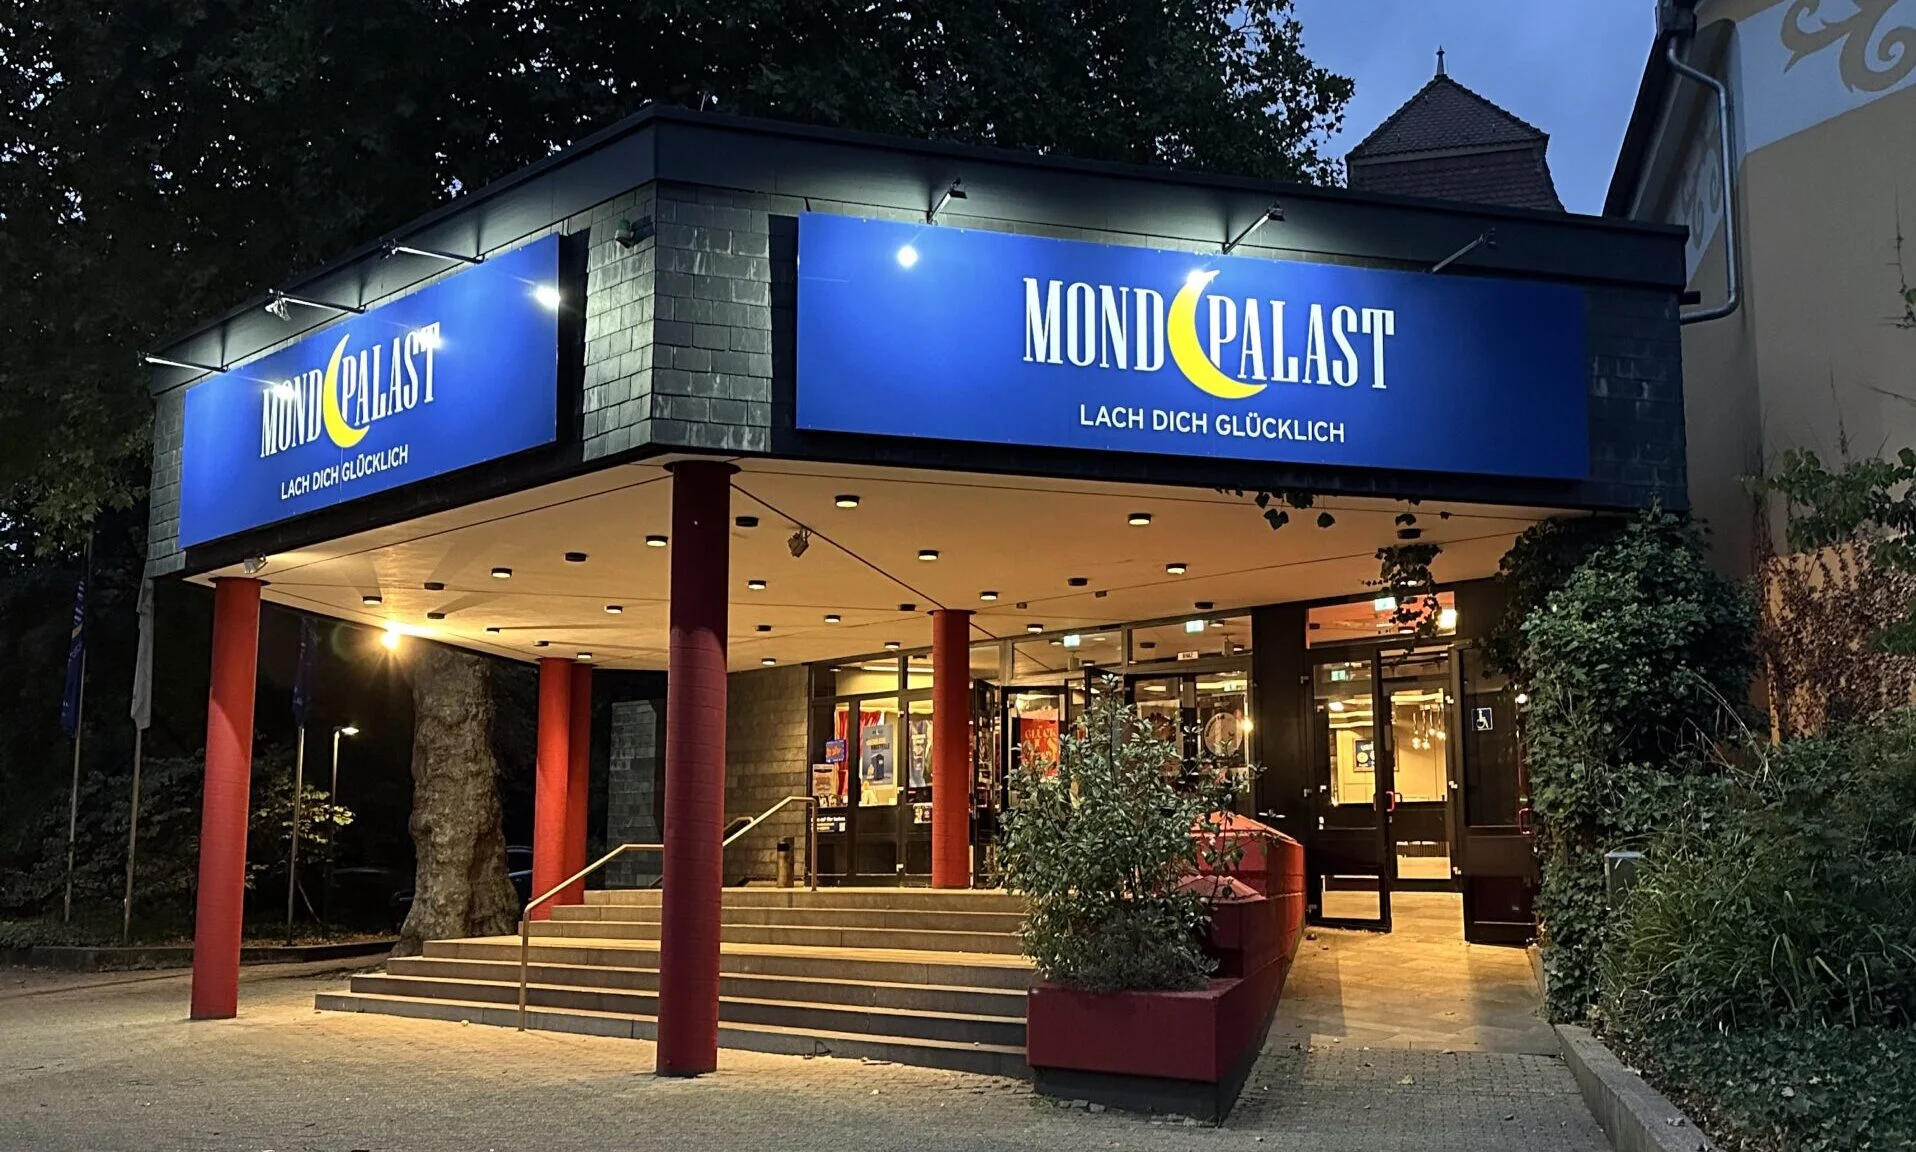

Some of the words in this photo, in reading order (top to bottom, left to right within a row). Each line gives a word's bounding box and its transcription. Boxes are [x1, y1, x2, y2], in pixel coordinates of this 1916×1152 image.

[1023, 277, 1164, 372] MOND
[1206, 294, 1395, 390] PALAST
[259, 368, 323, 458] MOND
[341, 321, 441, 427] PALAST
[1080, 403, 1144, 429] LACH
[1153, 409, 1208, 434] DICH
[1215, 411, 1345, 443] GLÜCKLICH
[281, 473, 310, 500] LACH
[312, 465, 339, 489] DICH
[341, 443, 409, 482] GLÜCKLICH
